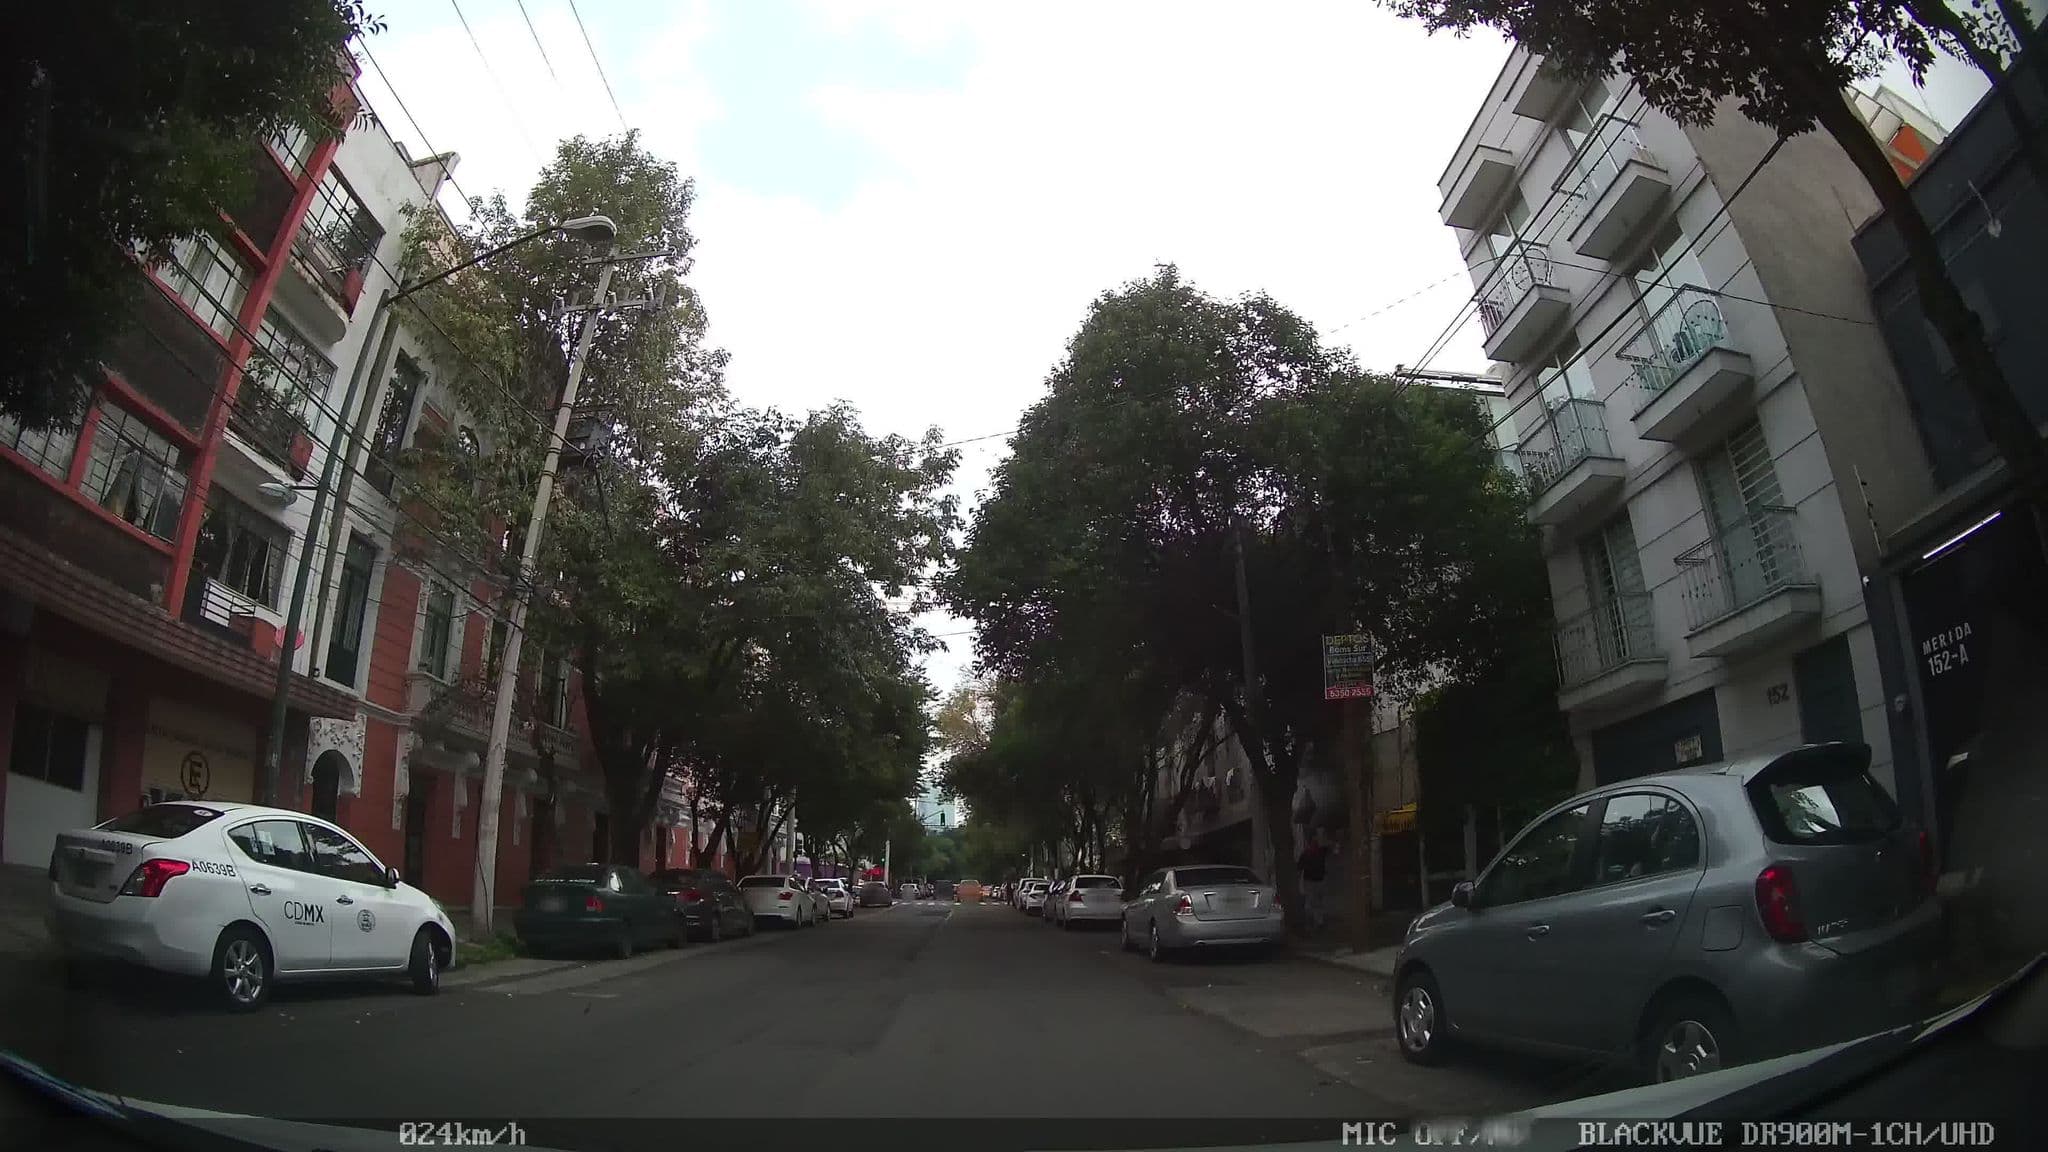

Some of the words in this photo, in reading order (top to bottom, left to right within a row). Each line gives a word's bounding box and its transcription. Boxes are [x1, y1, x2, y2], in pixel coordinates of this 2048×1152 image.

[1325, 633, 1369, 646] DEPTOS
[1921, 621, 1972, 656] MERIDA
[1927, 643, 1969, 677] 152-A
[1766, 683, 1790, 705] 152
[189, 760, 202, 788] E
[192, 859, 236, 877] A0639B
[283, 900, 325, 924] CDMX
